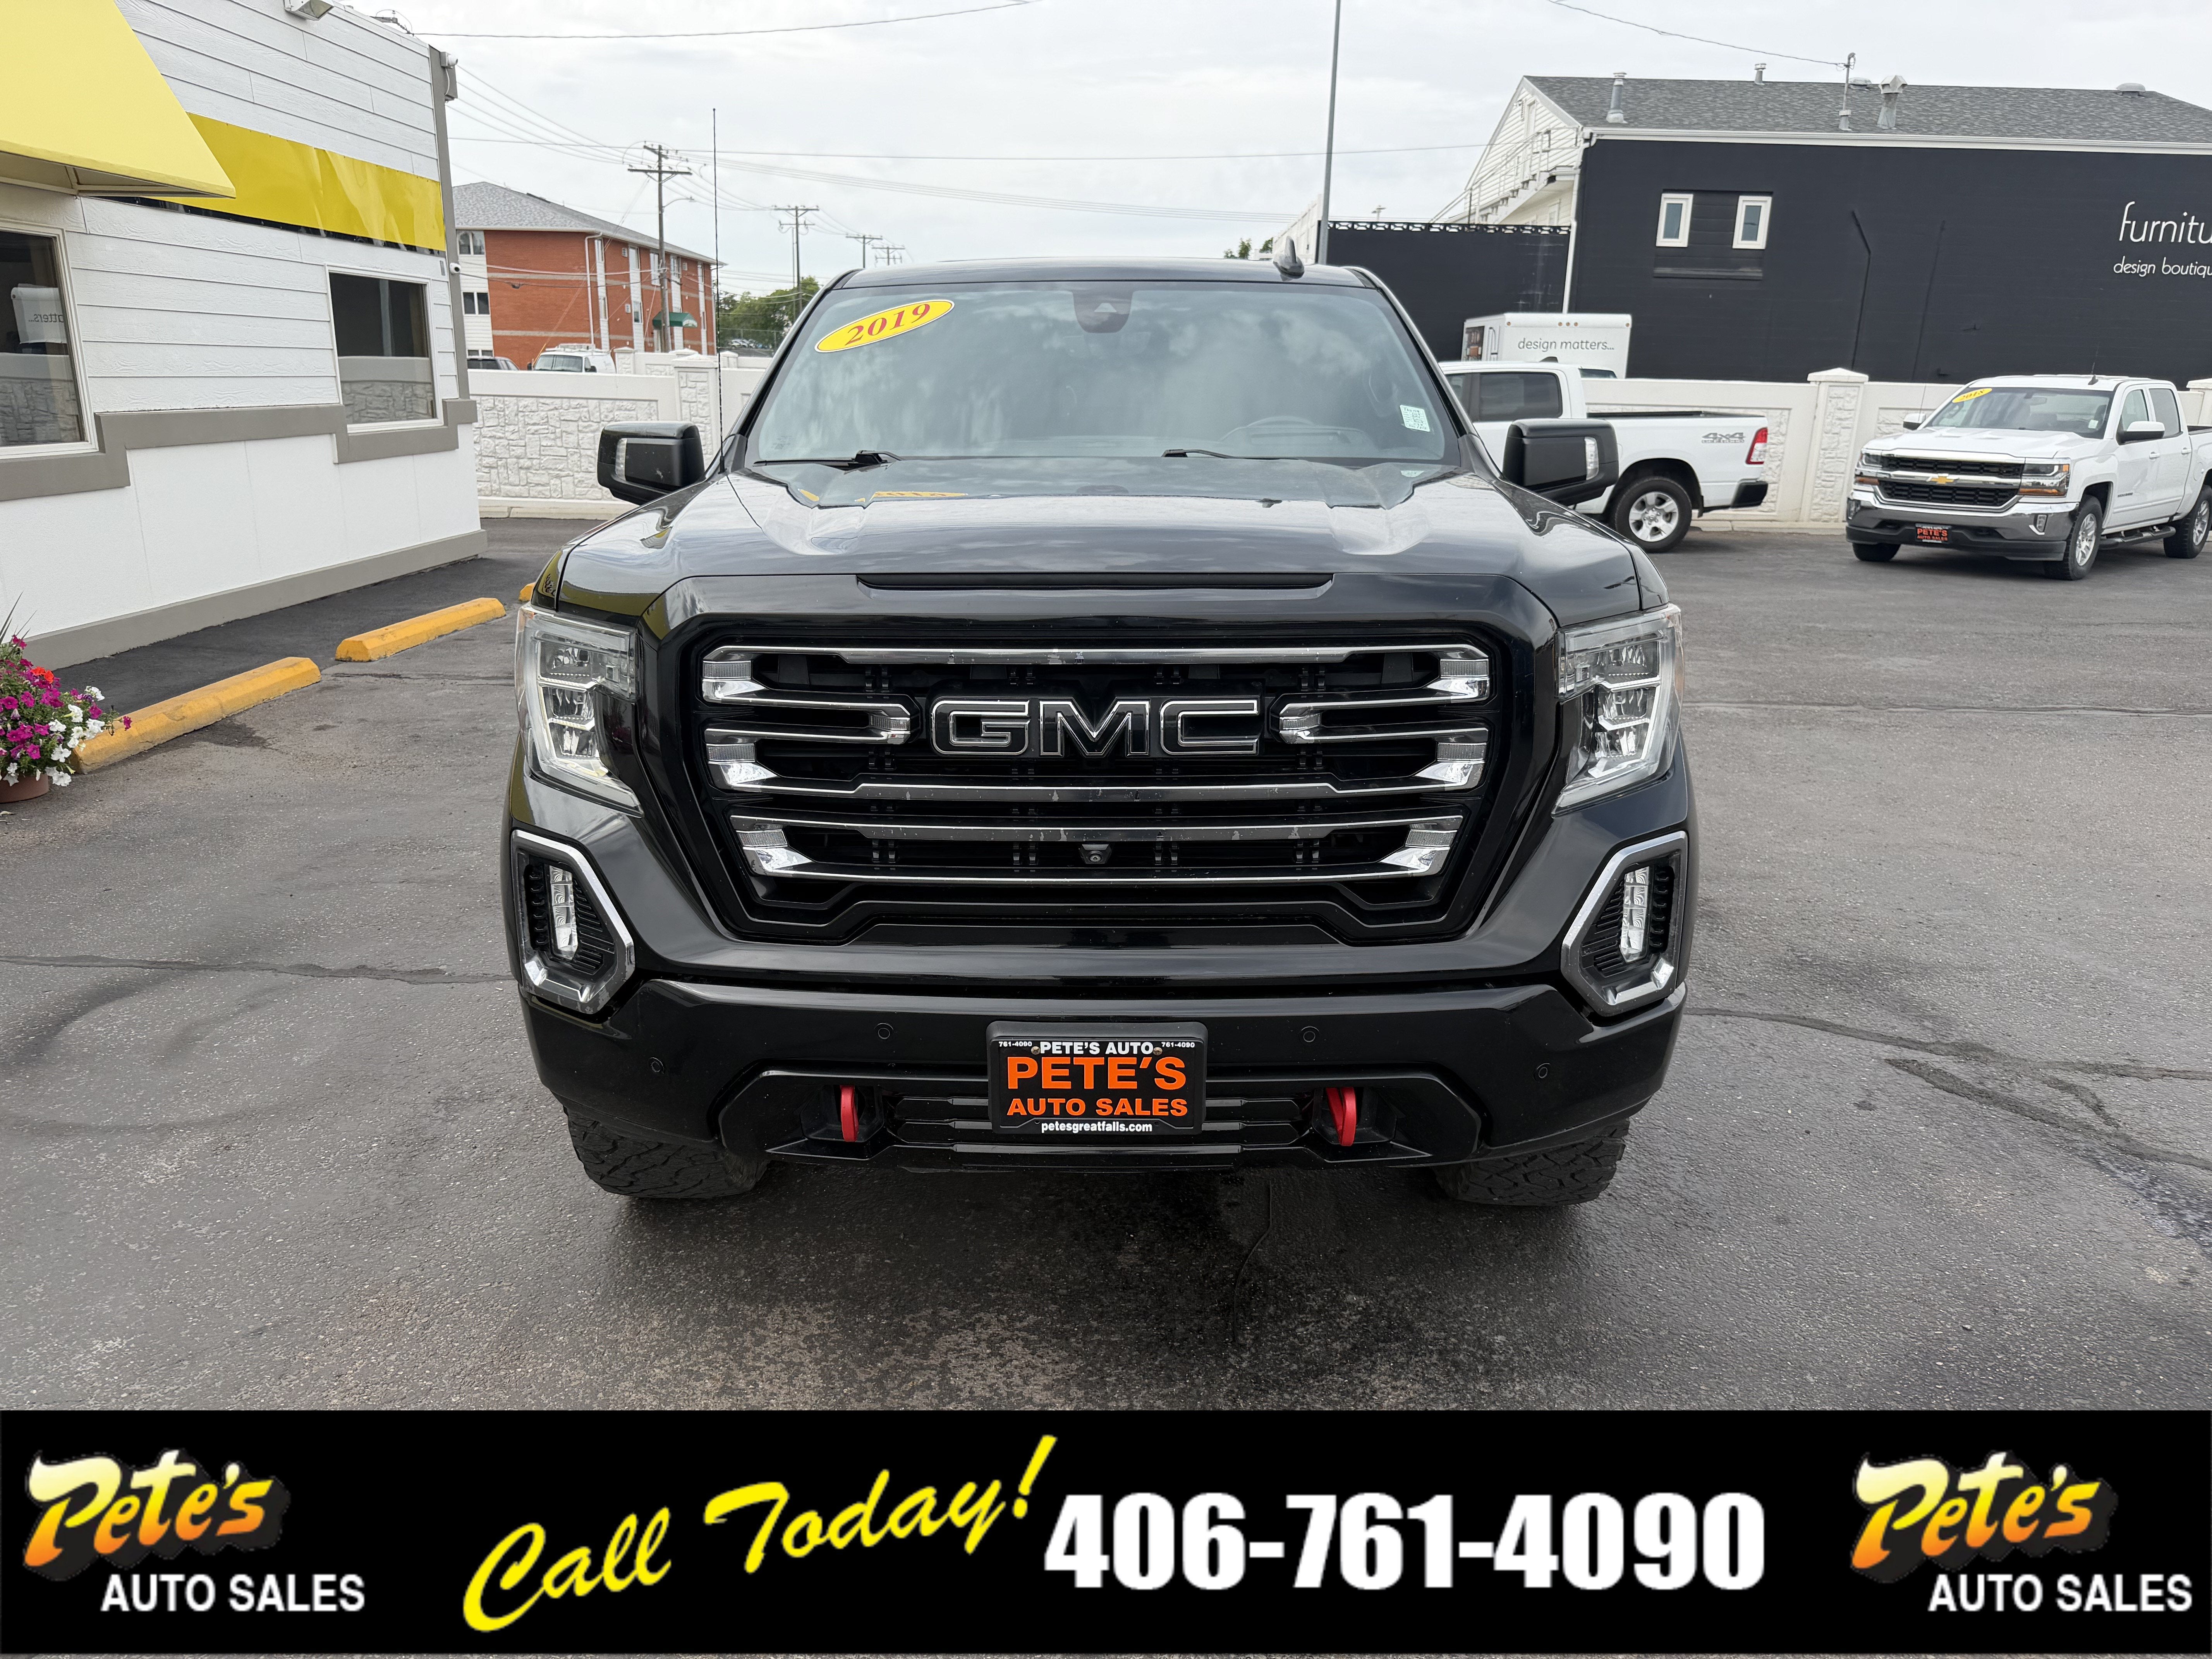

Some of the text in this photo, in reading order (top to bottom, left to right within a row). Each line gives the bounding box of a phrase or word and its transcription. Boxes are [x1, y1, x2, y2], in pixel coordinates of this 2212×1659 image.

[2119, 201, 2212, 244] furnitu
[2113, 256, 2156, 277] design
[845, 304, 930, 346] 2019
[1518, 337, 1615, 352] design matters...
[1917, 528, 1948, 537] PETE'S
[931, 698, 1259, 756] GMC
[1040, 1041, 1154, 1054] PETE'S AUTO
[1008, 1057, 1186, 1090] PETE'S
[1007, 1098, 1188, 1116] AUTO SALES
[1041, 1120, 1152, 1133] petesgreatfalls.com
